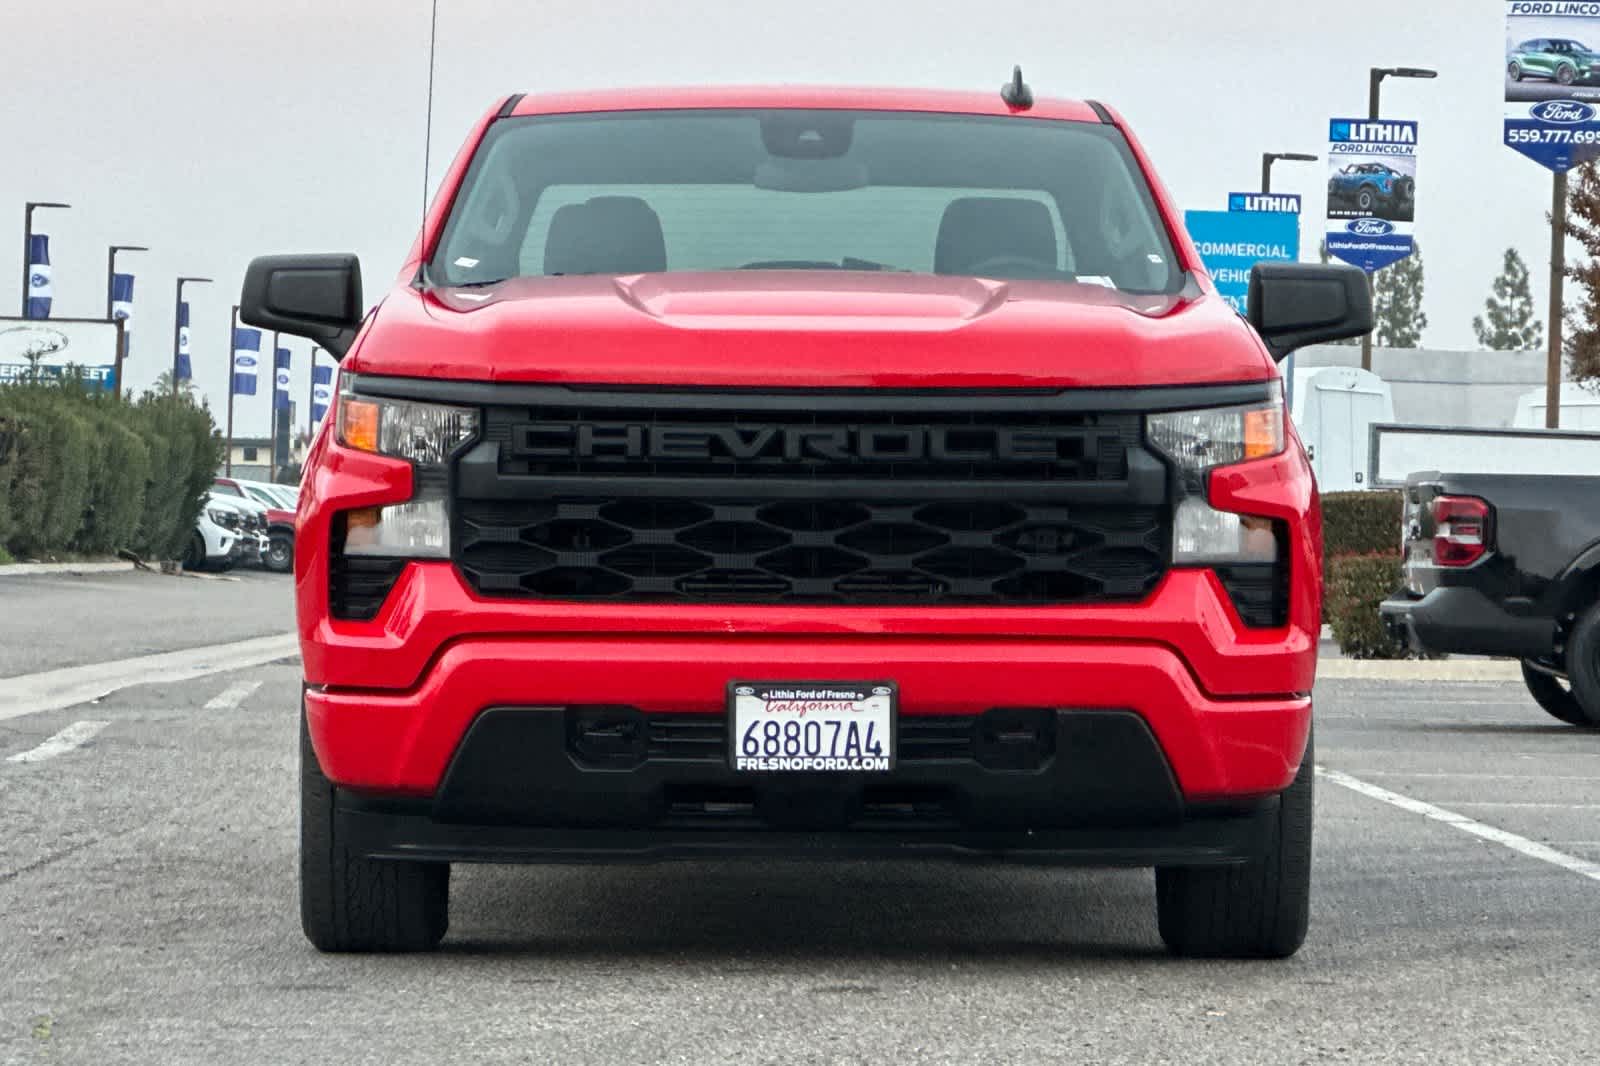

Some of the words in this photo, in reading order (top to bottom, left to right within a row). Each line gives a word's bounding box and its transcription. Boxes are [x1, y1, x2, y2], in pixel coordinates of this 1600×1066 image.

[1511, 3, 1553, 14] FORD
[1543, 103, 1583, 120] Ford
[1350, 123, 1414, 142] LITHIA
[1332, 143, 1364, 153] FORD
[1365, 144, 1414, 154] LINCOLN
[1245, 196, 1299, 213] LITHIA
[1354, 220, 1386, 234] Ford
[1208, 267, 1252, 283] VEHIC
[512, 422, 1120, 464] CHEVROLET
[769, 690, 795, 700] Lithia
[796, 690, 815, 699] Ford
[816, 690, 826, 699] of
[827, 690, 856, 699] Fresno
[766, 699, 864, 718] California
[742, 720, 882, 757] 68807A4
[736, 757, 889, 771] FRESNOFORD.COM
